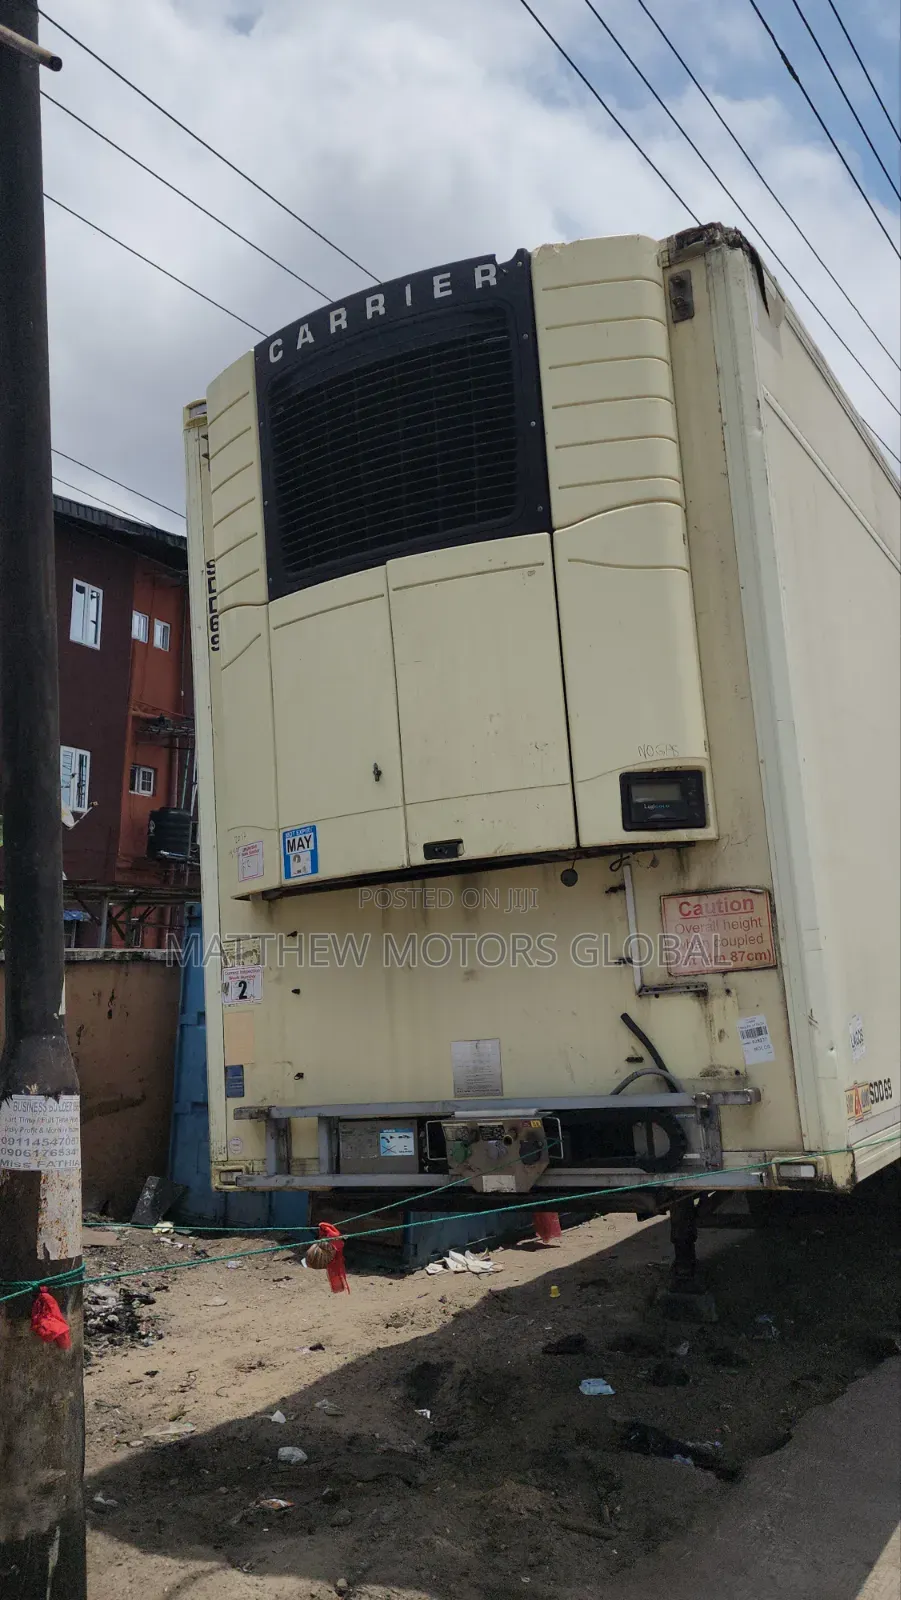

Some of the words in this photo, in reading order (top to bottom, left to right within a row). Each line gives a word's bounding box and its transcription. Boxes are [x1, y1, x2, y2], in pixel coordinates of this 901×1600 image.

[268, 263, 497, 363] CARRIER
[287, 834, 312, 853] MAY
[679, 897, 754, 917] Caution
[675, 920, 720, 934] Overall
[723, 917, 763, 931] height
[715, 933, 764, 951] coupled
[238, 980, 247, 999] 2
[13, 1101, 47, 1113] BUSINESS
